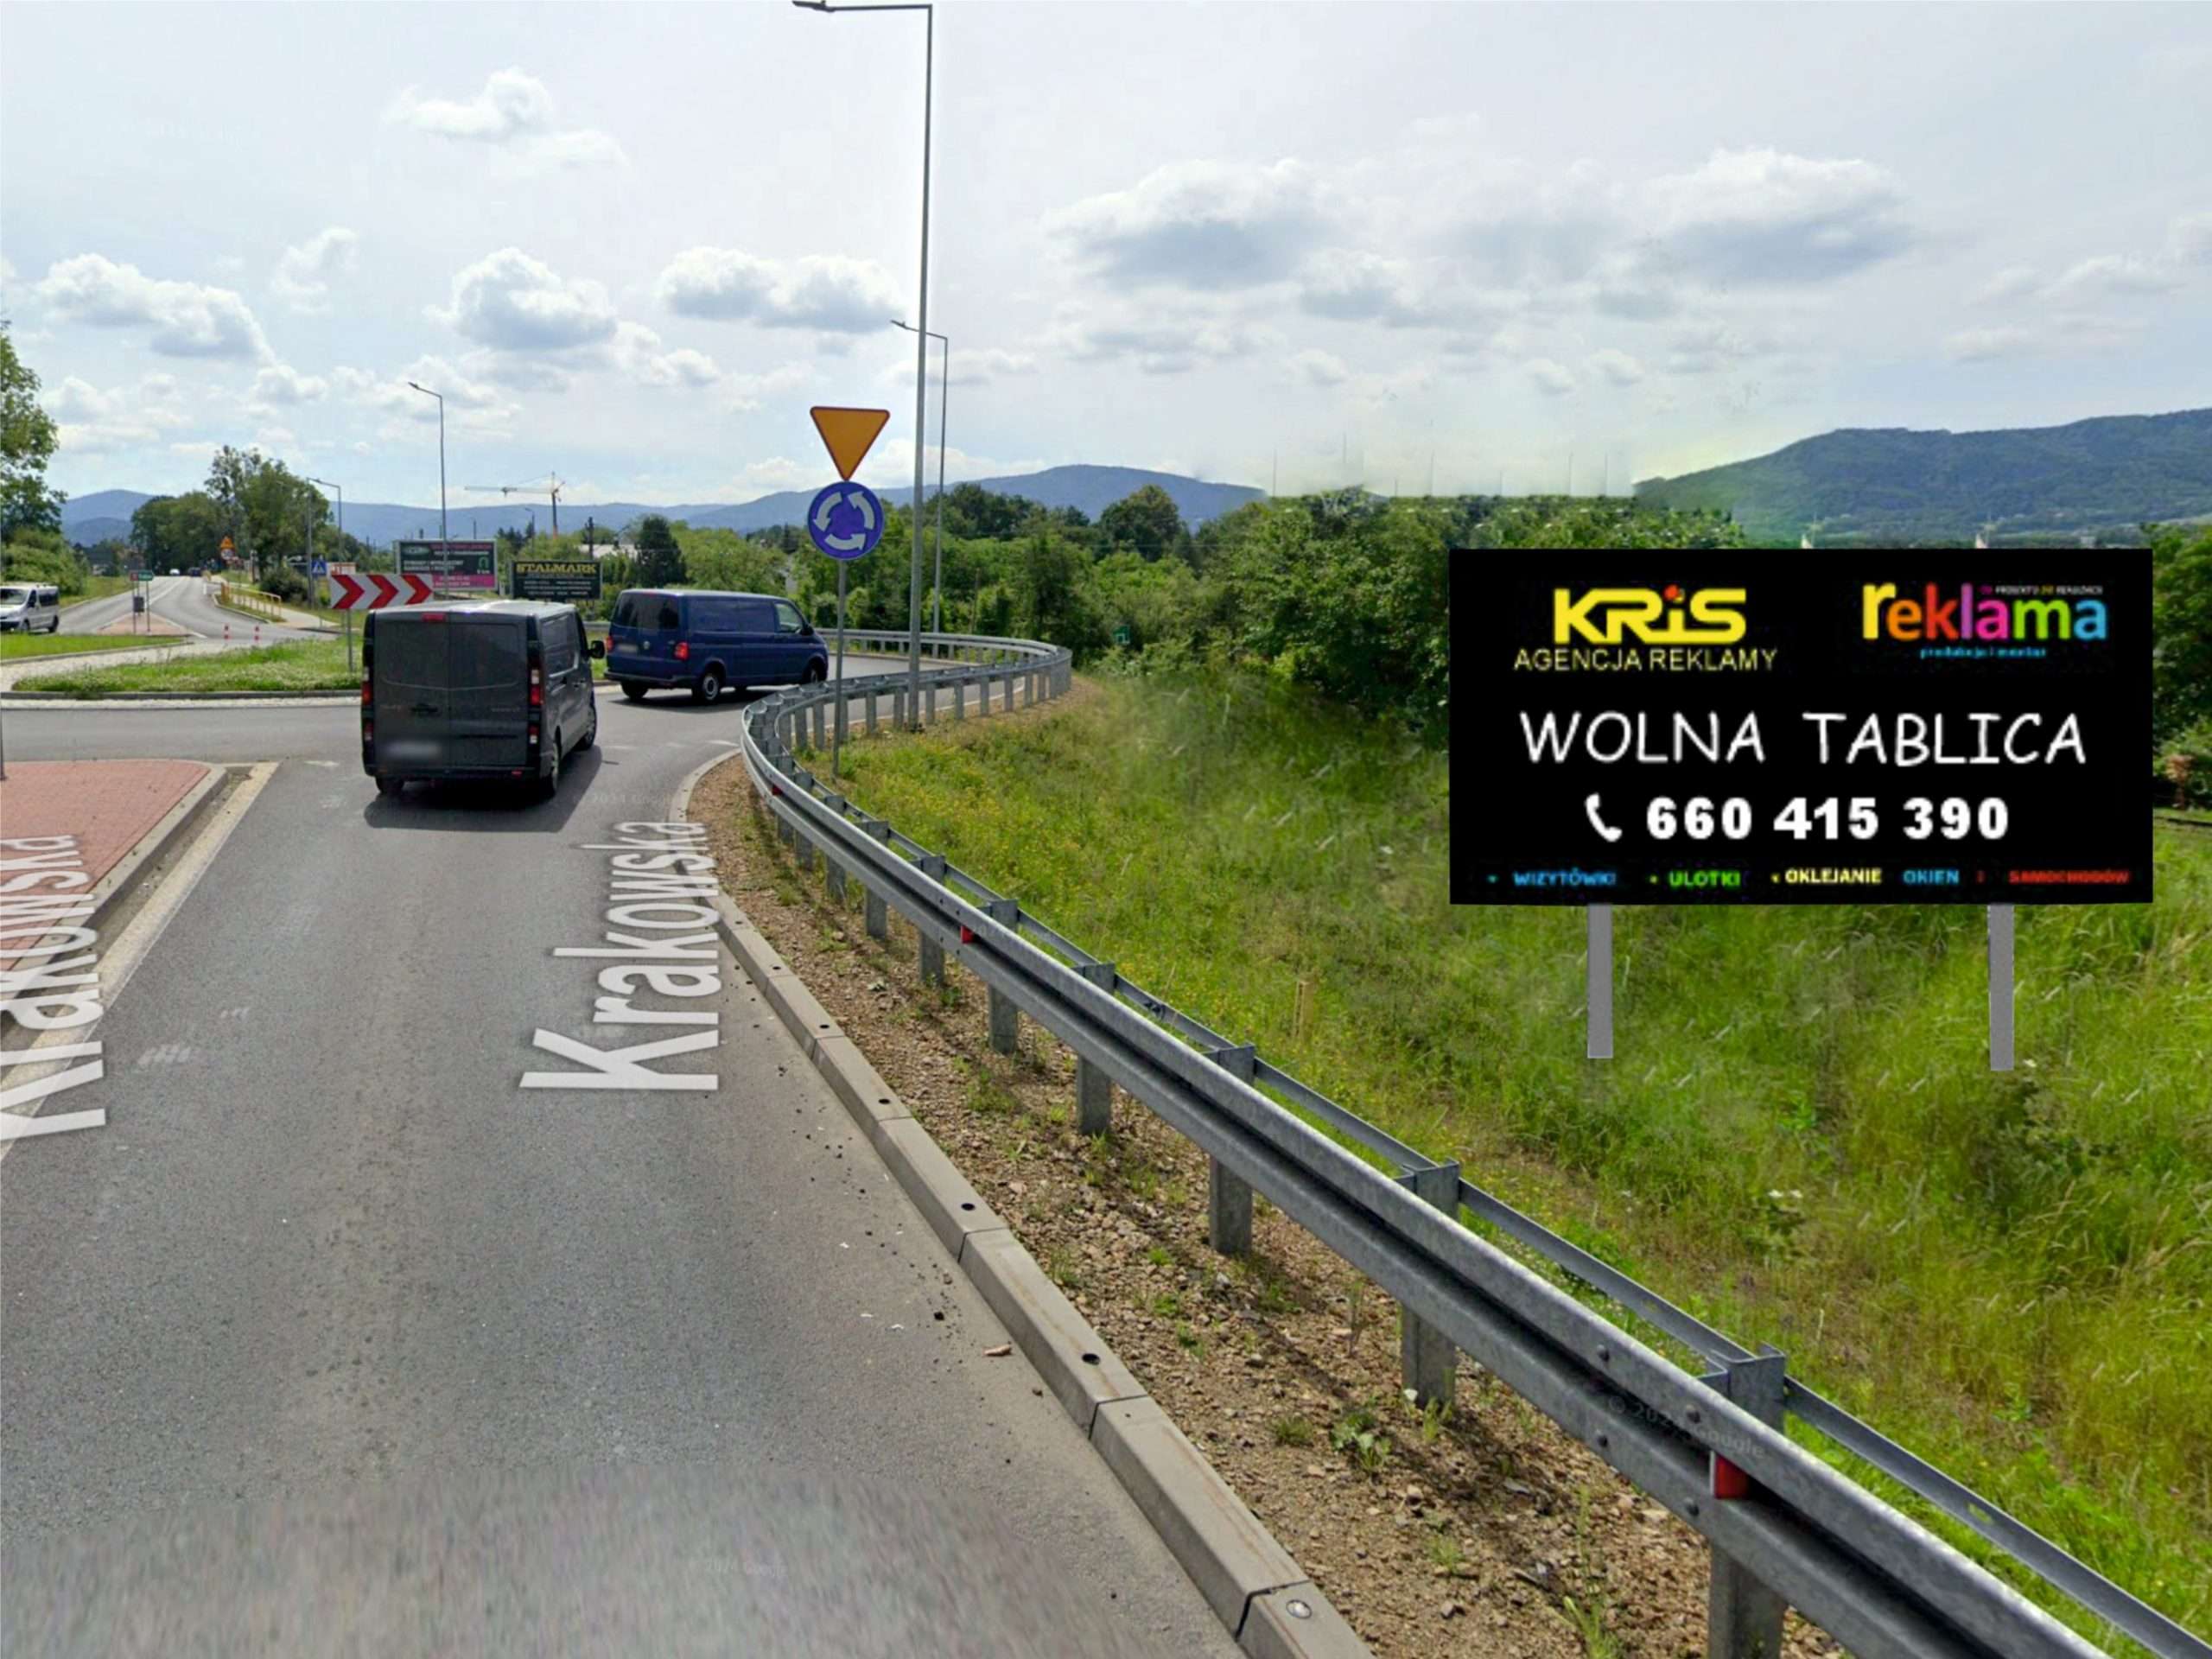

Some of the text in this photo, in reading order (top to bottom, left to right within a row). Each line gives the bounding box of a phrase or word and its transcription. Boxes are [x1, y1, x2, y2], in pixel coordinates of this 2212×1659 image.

[1862, 582, 2108, 641] reklama
[1514, 648, 1777, 671] AGENCJA REKLAMY
[1519, 711, 2087, 767] WOLNA TABLICA
[1646, 796, 2009, 841] 660 415 390
[1513, 868, 1617, 887] WIZYTÓWKI
[1668, 870, 1741, 887] ULOTKI
[1785, 868, 1883, 885] OKLEJANIE
[1903, 869, 1960, 885] OKIEN
